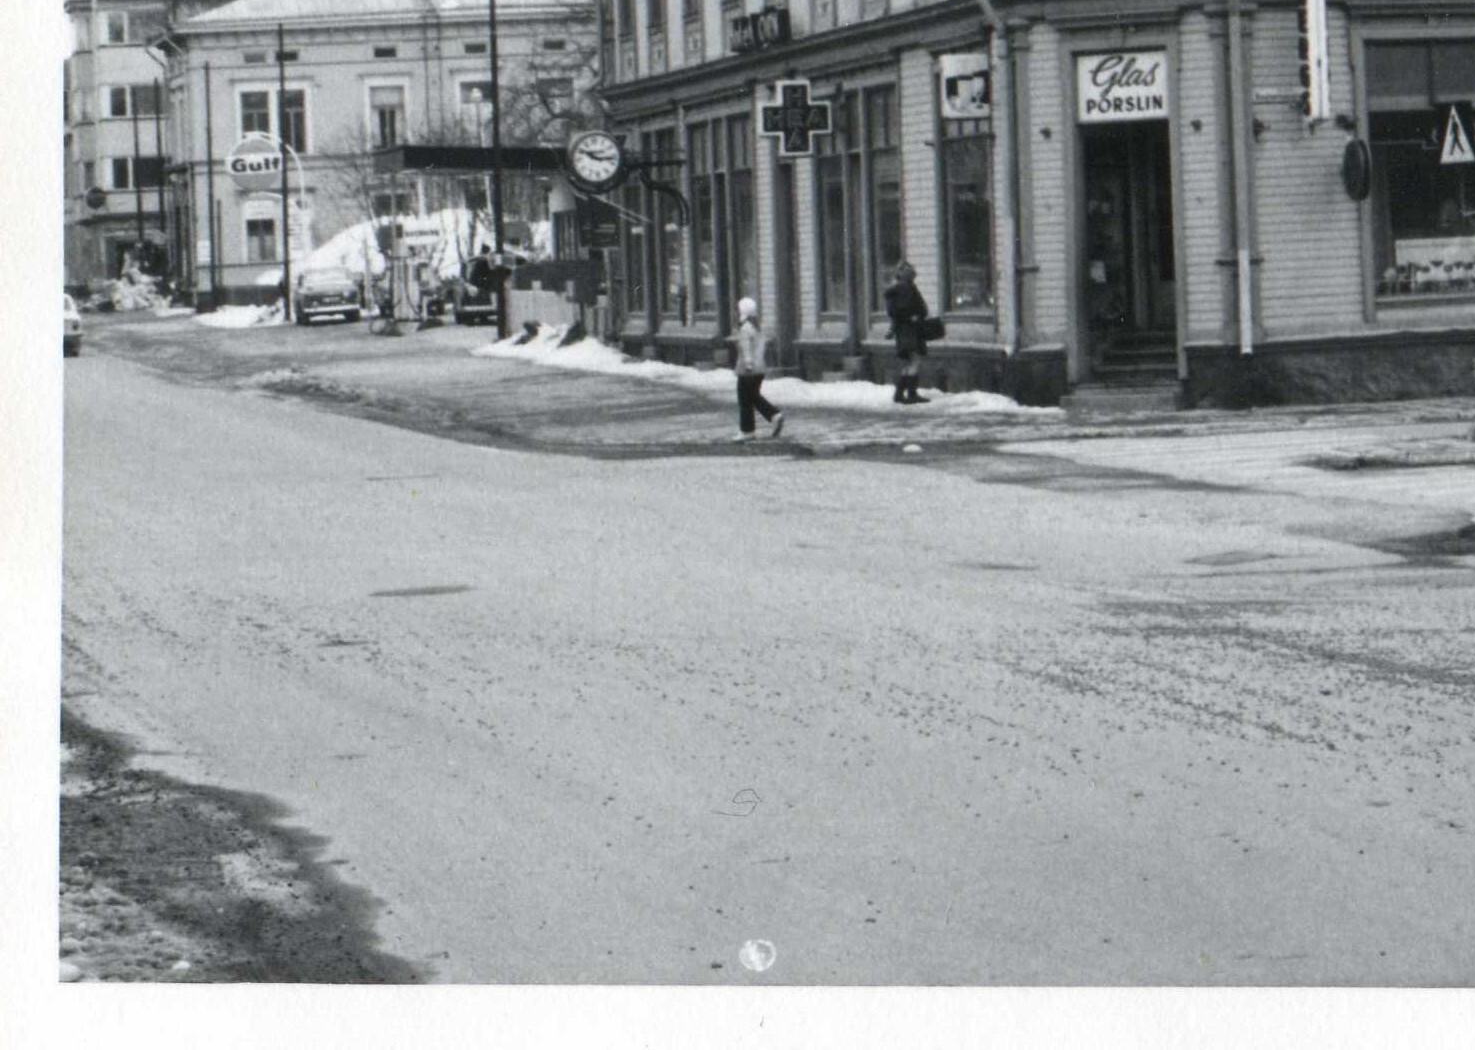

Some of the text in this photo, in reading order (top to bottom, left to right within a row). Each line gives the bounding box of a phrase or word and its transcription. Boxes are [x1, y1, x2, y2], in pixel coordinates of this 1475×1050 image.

[1089, 54, 1160, 98] Glas
[1086, 96, 1163, 114] PORSLIN
[231, 157, 280, 173] Gulf
